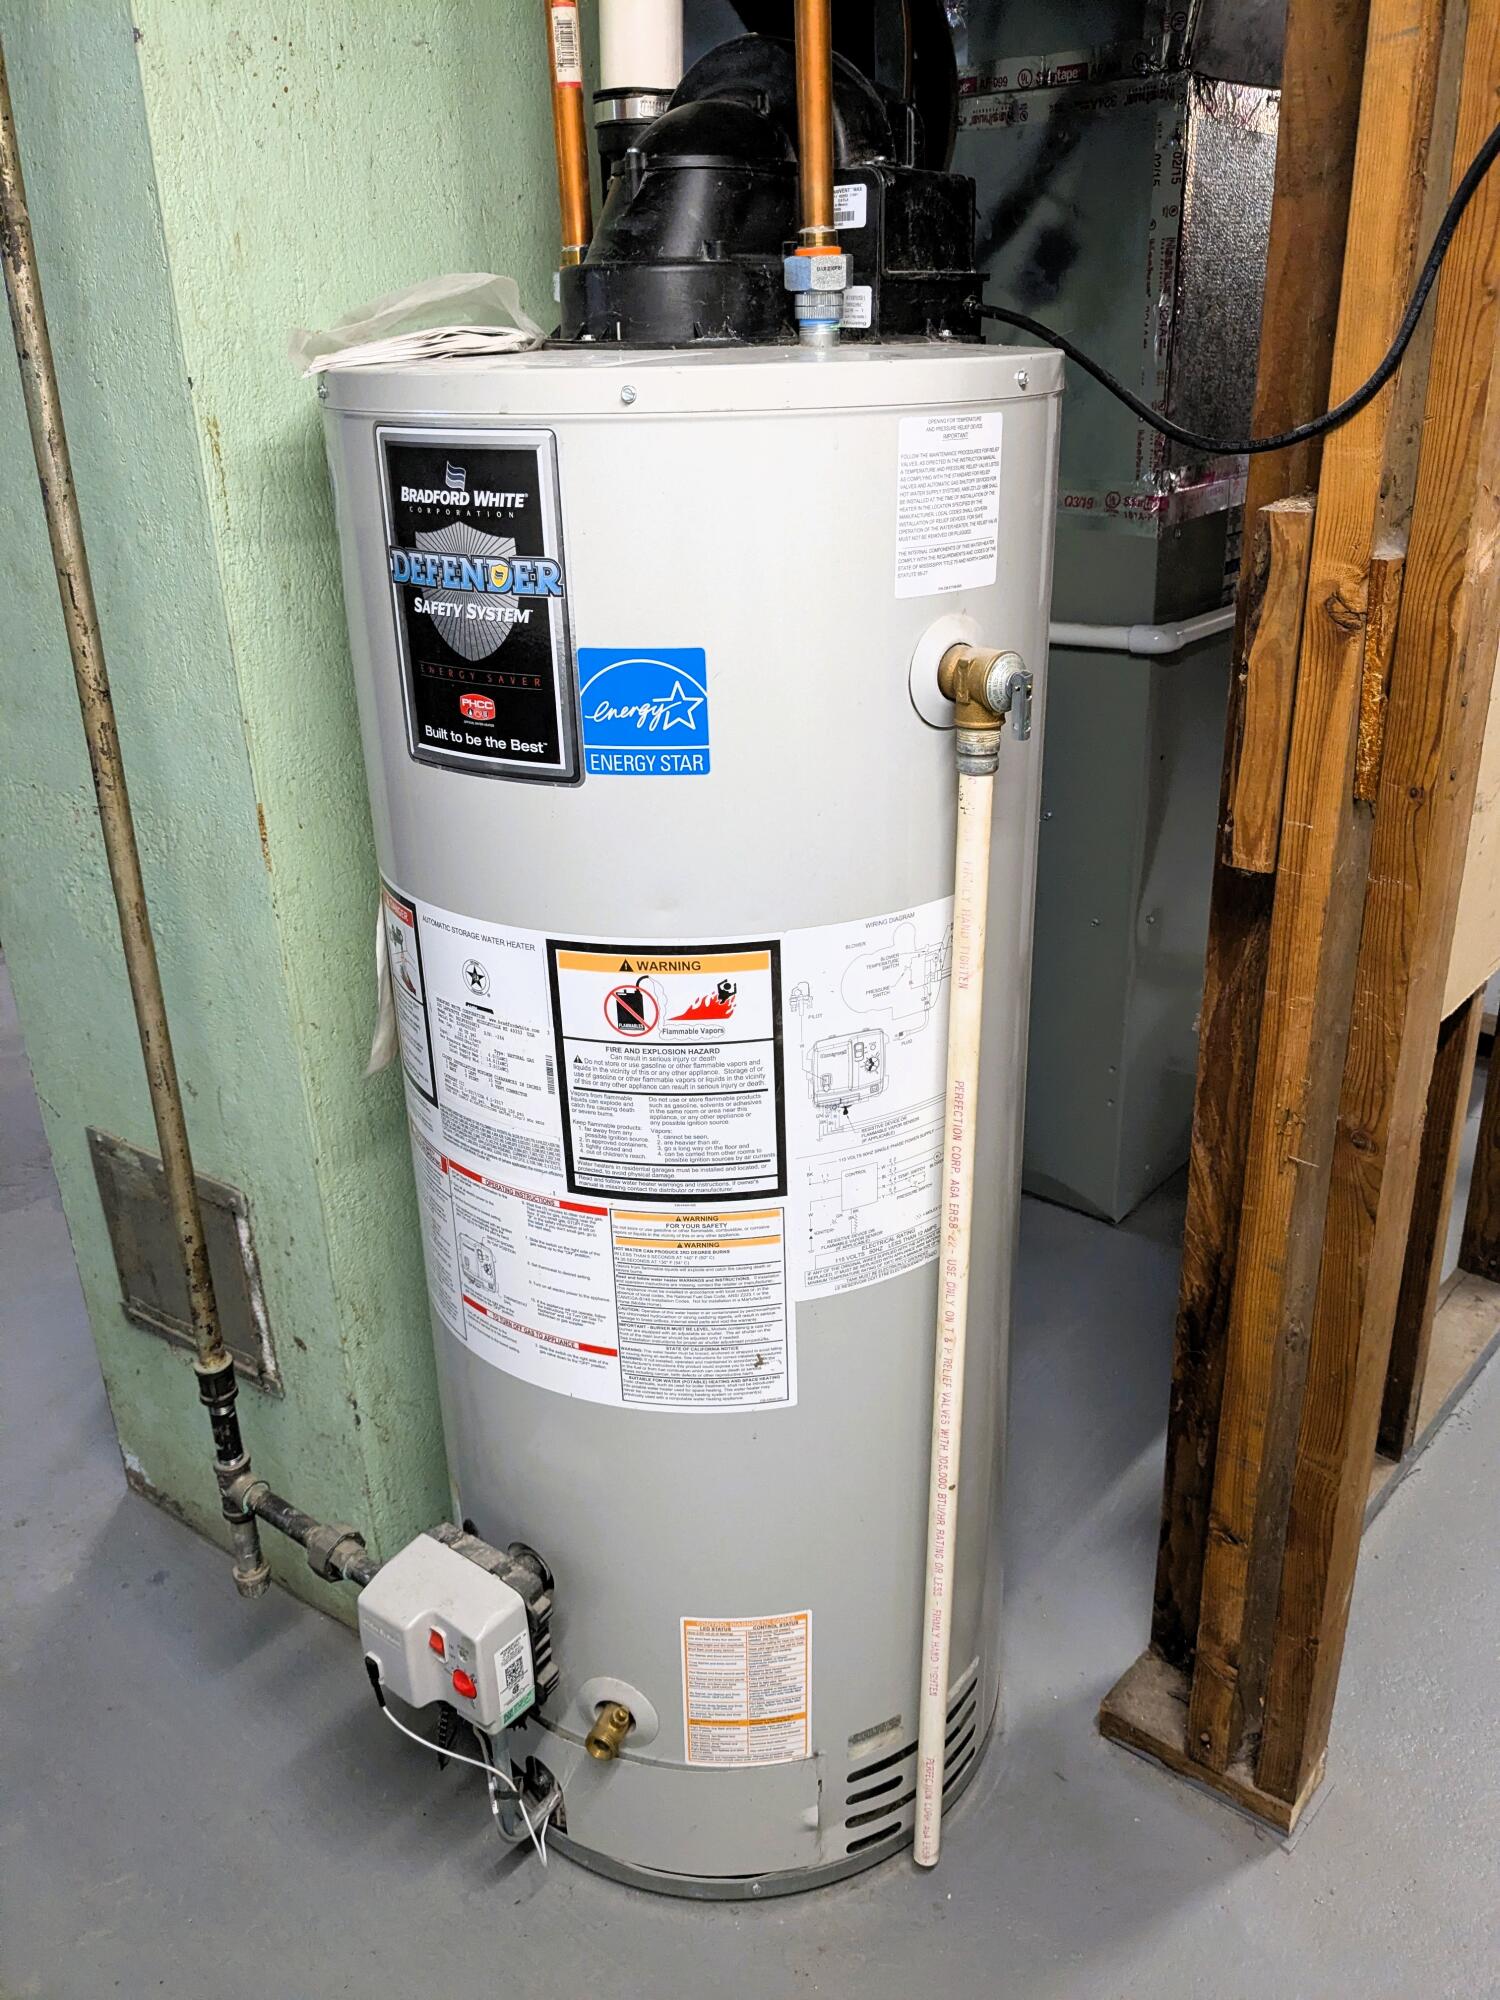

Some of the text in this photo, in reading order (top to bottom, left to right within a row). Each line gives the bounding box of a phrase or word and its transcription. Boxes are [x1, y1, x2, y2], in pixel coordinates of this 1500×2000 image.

[1171, 152, 1182, 185] 02/15
[401, 486, 470, 506] BRADFORD
[409, 506, 514, 519] CORPORATION
[391, 548, 564, 597] DEFENDER
[414, 597, 463, 618] SAFETY
[420, 663, 541, 687] ENERGY SAVER
[461, 698, 494, 710] PHCC
[585, 700, 674, 732] energy
[424, 725, 448, 741] Built
[450, 729, 462, 743] to
[466, 733, 481, 746] be
[485, 736, 506, 749] the
[590, 754, 704, 772] ENERGY STAR
[865, 912, 914, 928] WIRING DIAGRAM
[422, 915, 534, 950] AUTOMATIC STORAGE WATER HEATER
[637, 960, 700, 971] WARNING
[951, 1080, 965, 1141] PERFECTION
[485, 1179, 554, 1207] OPERATING INSTRUCTIONS
[949, 1179, 961, 1198] AGA
[861, 1236, 894, 1249] ELECTRICAL
[896, 1228, 915, 1239] RATING
[946, 1259, 957, 1277] USE
[944, 1281, 957, 1305] ONLY
[944, 1309, 955, 1324] ON
[492, 1313, 574, 1348] TO TURN OFF GAS TO APPLIANCE
[942, 1358, 953, 1388] RELIEF
[940, 1391, 951, 1425] VALVES
[938, 1429, 950, 1452] WITH
[936, 1493, 947, 1526] BTU/HR
[934, 1528, 945, 1559] RATING
[933, 1561, 943, 1574] OR
[932, 1577, 942, 1597] LESS
